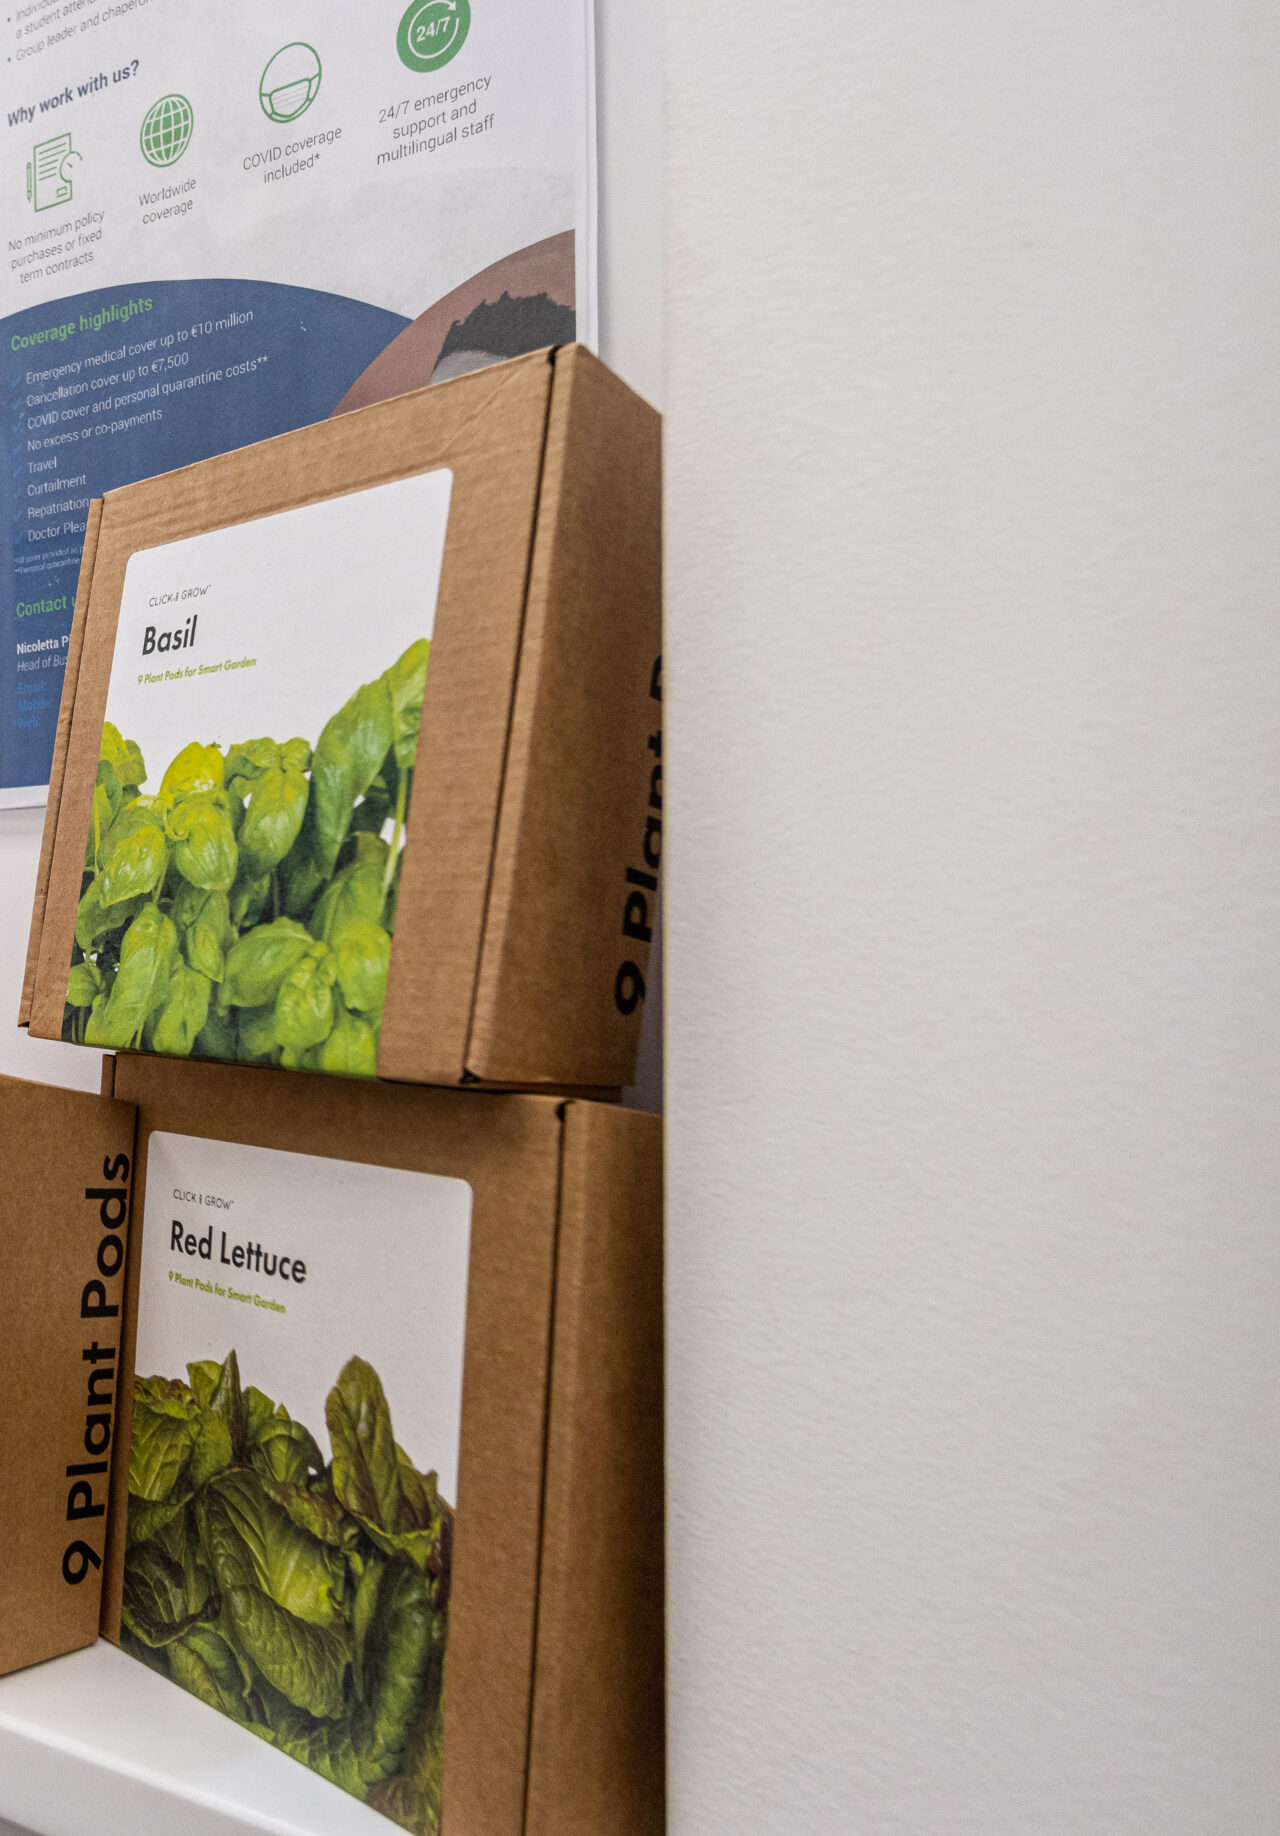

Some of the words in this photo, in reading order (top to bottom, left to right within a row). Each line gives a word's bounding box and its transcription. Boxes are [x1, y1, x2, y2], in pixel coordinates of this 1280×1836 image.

[16, 41, 45, 61] Group
[47, 25, 76, 47] leader
[80, 12, 100, 32] and
[24, 8, 61, 35] student
[416, 16, 451, 42] 24/7
[7, 104, 35, 127] Why
[39, 88, 73, 113] work
[76, 73, 108, 98] with
[112, 59, 139, 83] us?
[378, 101, 410, 123] 24/7
[413, 75, 492, 112] emergency
[376, 129, 458, 165] multilingual
[461, 113, 495, 139] staff
[393, 113, 446, 140] support
[450, 98, 477, 121] and
[243, 146, 282, 171] COVID
[284, 127, 342, 157] coverage
[138, 177, 197, 207] Worldwide
[142, 199, 193, 225] coverage
[8, 240, 23, 251] No
[24, 223, 73, 247] minimum
[75, 210, 104, 232] policy
[11, 244, 63, 271] purchases
[65, 240, 76, 251] or
[78, 226, 102, 247] fixed
[20, 268, 44, 284] term
[45, 251, 94, 275] contracts
[10, 322, 76, 351] Coverage
[79, 297, 153, 332] highlights
[26, 360, 82, 385] Emergency
[84, 345, 126, 368] medical
[128, 339, 158, 357] cover
[160, 334, 175, 348] up
[177, 330, 189, 342] to
[191, 320, 213, 338] €10
[215, 310, 254, 332] million
[26, 382, 89, 407] Cancellation
[90, 374, 120, 390] cover
[122, 369, 136, 383] up
[138, 365, 149, 377] to
[151, 352, 189, 373] €7,500
[27, 411, 59, 430] COVID
[61, 405, 90, 421] cover
[92, 396, 112, 413] and
[114, 383, 160, 410] personal
[162, 370, 223, 397] quarantine
[27, 440, 42, 453] No
[43, 431, 80, 449] excess
[81, 427, 93, 439] or
[94, 409, 163, 436] co-payments
[27, 474, 87, 497] Curtailment
[28, 456, 57, 474] Travel
[27, 496, 89, 519] Repatriation
[28, 526, 61, 542] Doctor
[16, 595, 67, 618] Contact
[149, 594, 174, 607] CLICK
[17, 638, 59, 655] Nicoletta
[142, 614, 198, 656] Basil
[17, 656, 40, 672] Head
[41, 655, 52, 669] of
[137, 674, 143, 685] 9
[144, 672, 163, 684] Plant
[164, 668, 183, 681] Pods
[185, 665, 197, 678] for
[198, 661, 223, 676] Smart
[223, 656, 257, 671] Garden
[613, 960, 646, 1016] 9
[173, 1188, 196, 1203] CLICK
[80, 1151, 130, 1319] Pods
[170, 1219, 213, 1261] Red
[220, 1231, 307, 1284] Lettuce
[174, 1273, 193, 1288] Plant
[195, 1278, 213, 1294] Pods
[214, 1282, 226, 1297] for
[228, 1287, 252, 1304] Smart
[254, 1294, 286, 1314] Garden
[65, 1340, 118, 1521] Plant
[62, 1539, 102, 1586] 9
